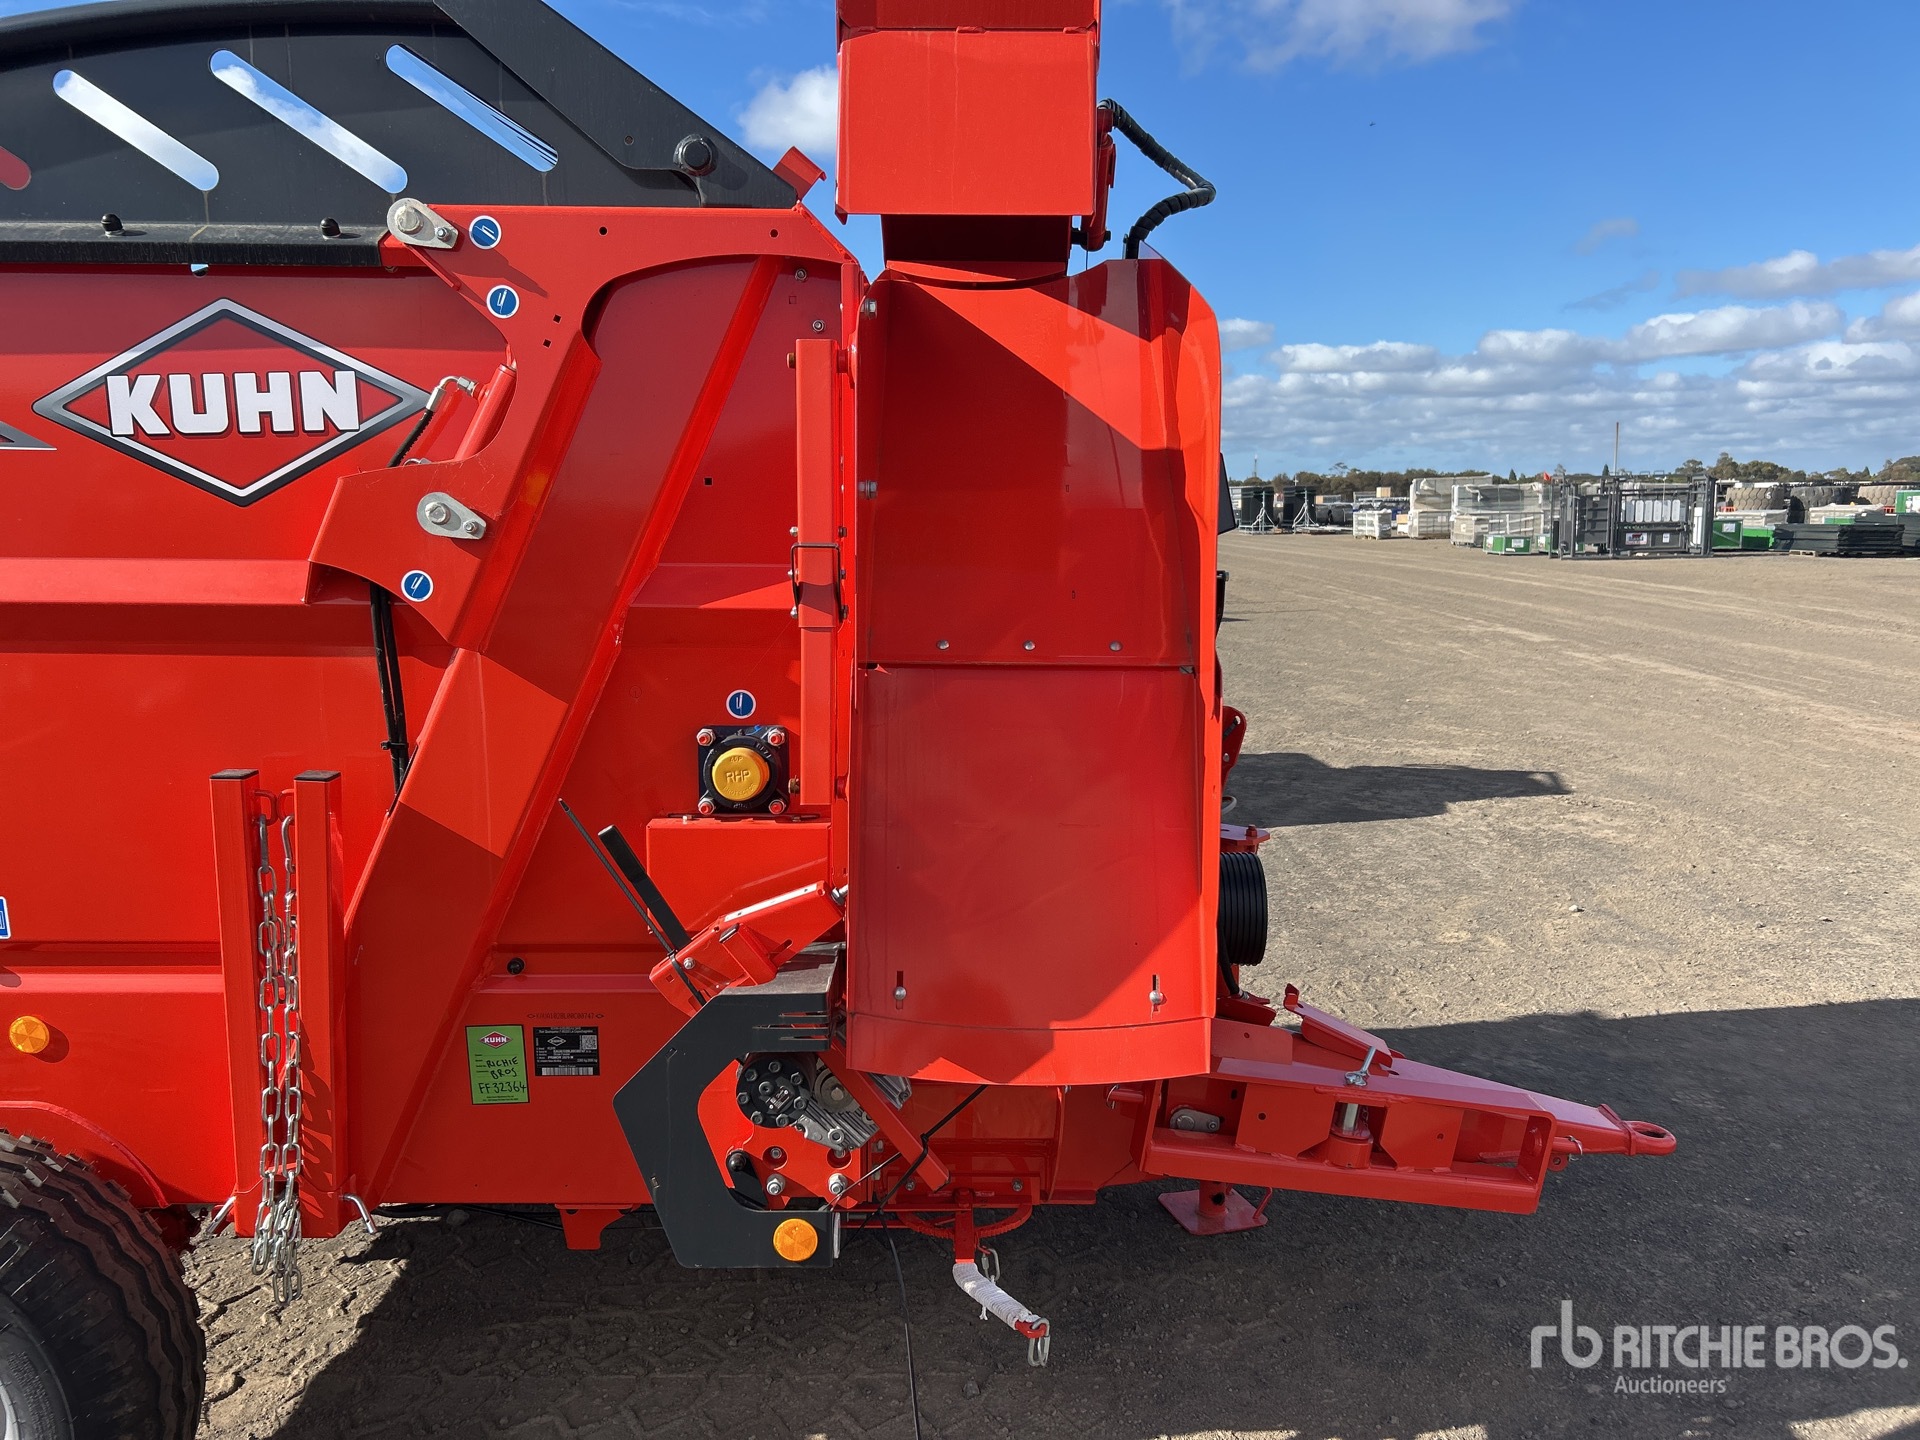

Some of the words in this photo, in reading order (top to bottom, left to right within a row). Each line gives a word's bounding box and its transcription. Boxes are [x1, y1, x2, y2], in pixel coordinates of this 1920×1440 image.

[107, 370, 360, 437] KUHN
[725, 770, 751, 784] RHP
[486, 1056, 519, 1068] RICHIE
[490, 1067, 518, 1080] BROS
